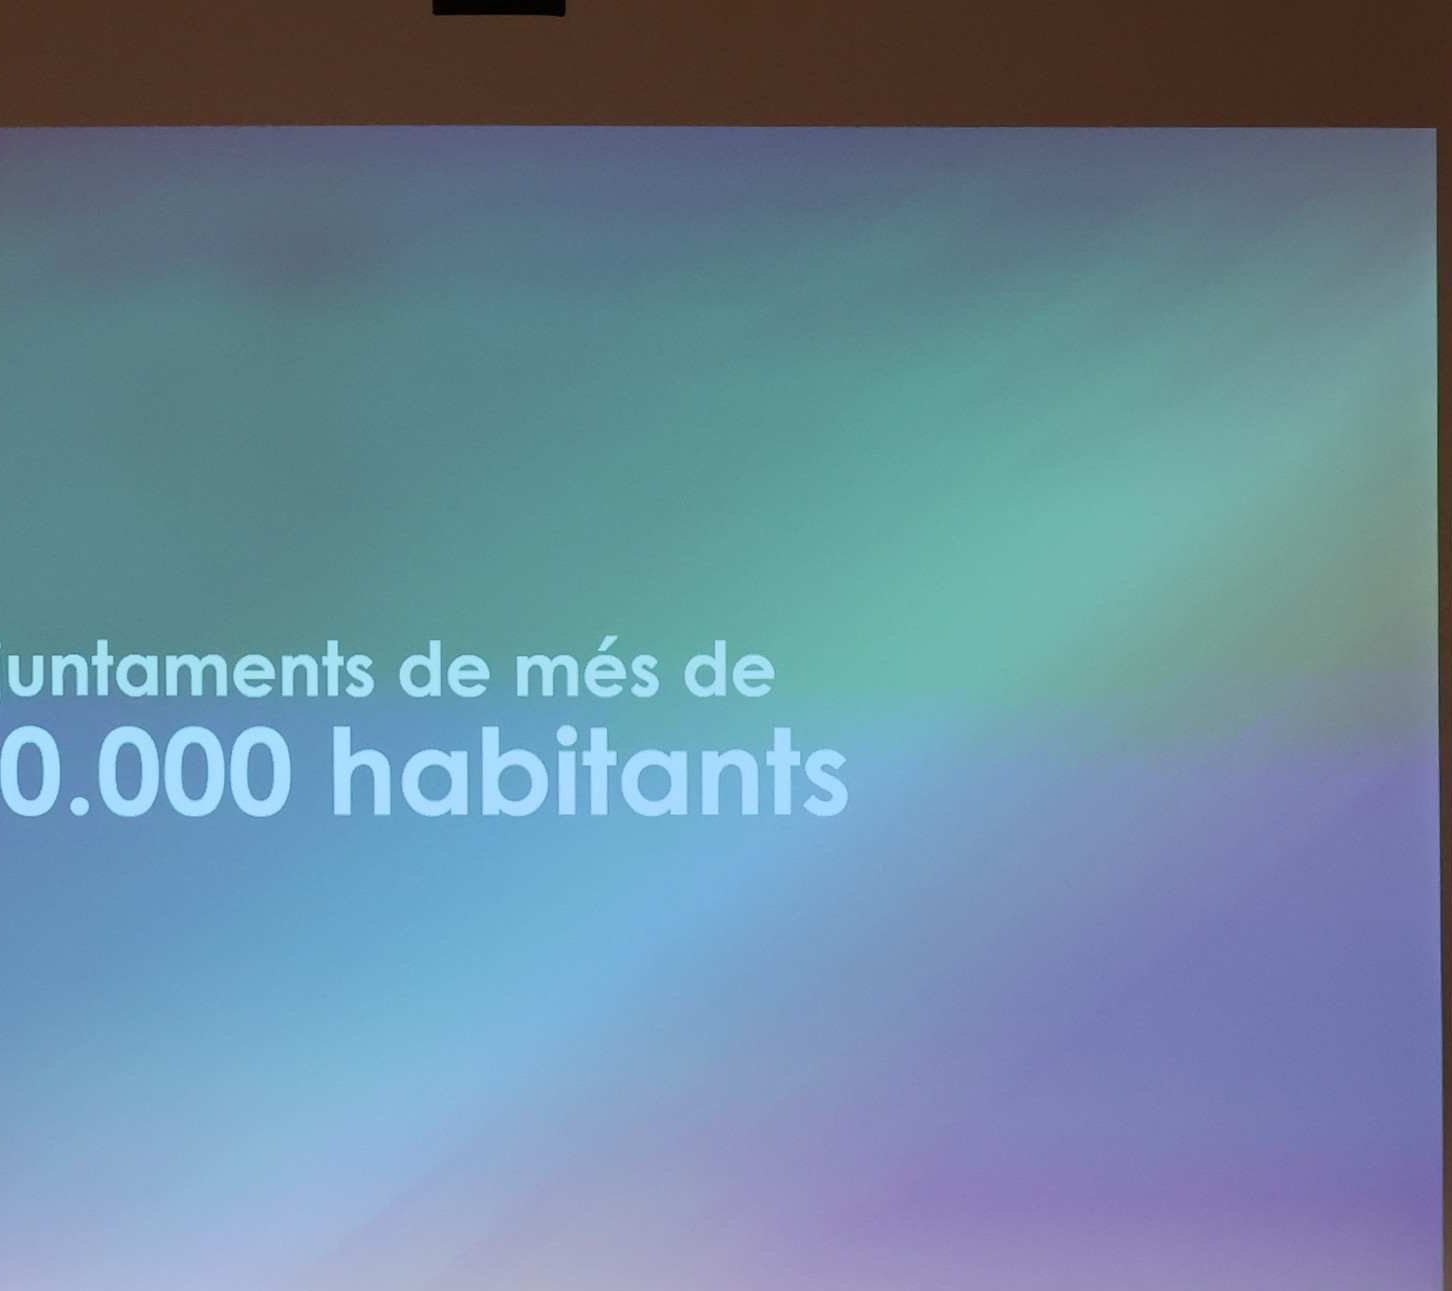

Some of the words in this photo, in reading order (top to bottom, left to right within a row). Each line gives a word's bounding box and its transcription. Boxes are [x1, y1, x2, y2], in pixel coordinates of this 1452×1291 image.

[398, 639, 490, 699] de
[516, 635, 659, 699] més
[683, 639, 775, 699] de
[332, 725, 849, 817] habitants
